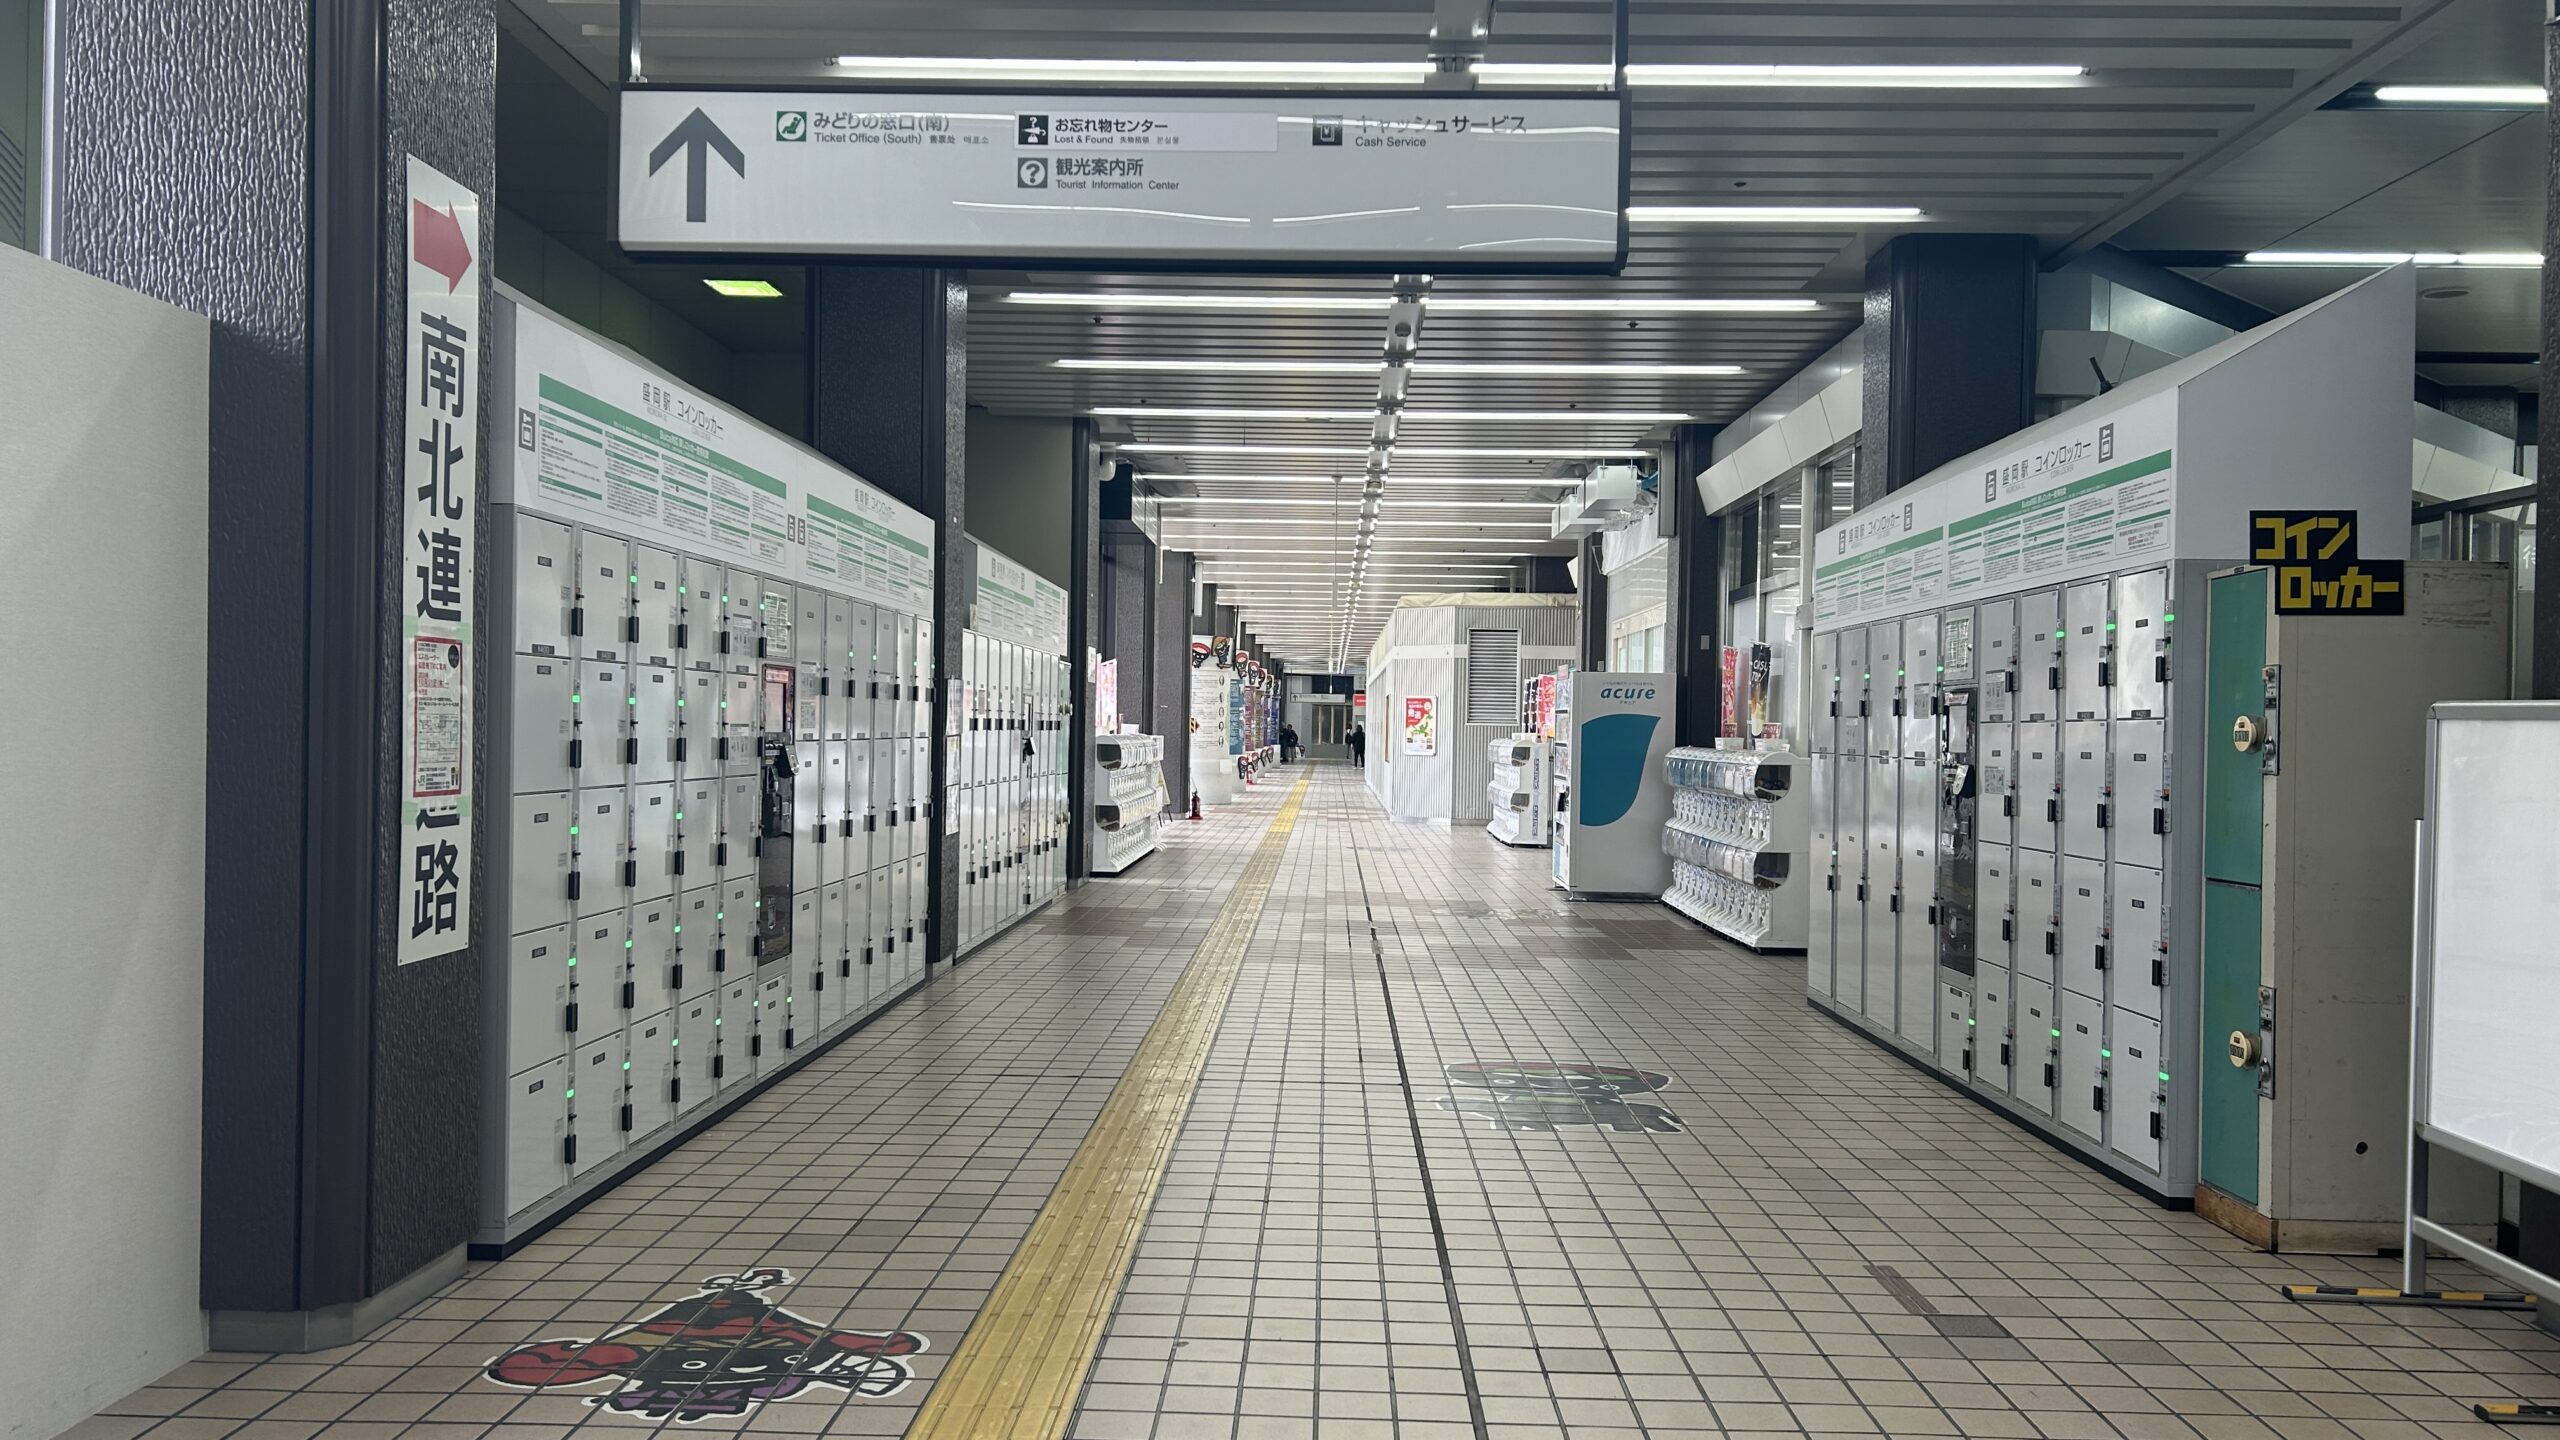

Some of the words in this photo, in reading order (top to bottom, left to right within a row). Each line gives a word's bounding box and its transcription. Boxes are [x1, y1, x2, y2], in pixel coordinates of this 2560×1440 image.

[1054, 118, 1169, 134] お忘れ物センター
[815, 132, 846, 143] Ticket
[849, 132, 880, 144] Office
[883, 133, 922, 145] (South)
[1054, 135, 1074, 144] Lost
[1076, 135, 1083, 144] &
[1085, 135, 1114, 144] Found
[1355, 136, 1383, 147] Cash
[1387, 136, 1427, 147] Service
[1056, 158, 1144, 177] 観光案内所
[1056, 179, 1087, 189] Tourist
[1092, 180, 1143, 190] Information
[1148, 180, 1180, 190] Center
[677, 400, 724, 434] コインロッカー
[2035, 440, 2092, 473] コインロッカー
[2255, 516, 2350, 560] コイン
[2280, 566, 2400, 609] ロッカー
[1600, 688, 1656, 699] acure
